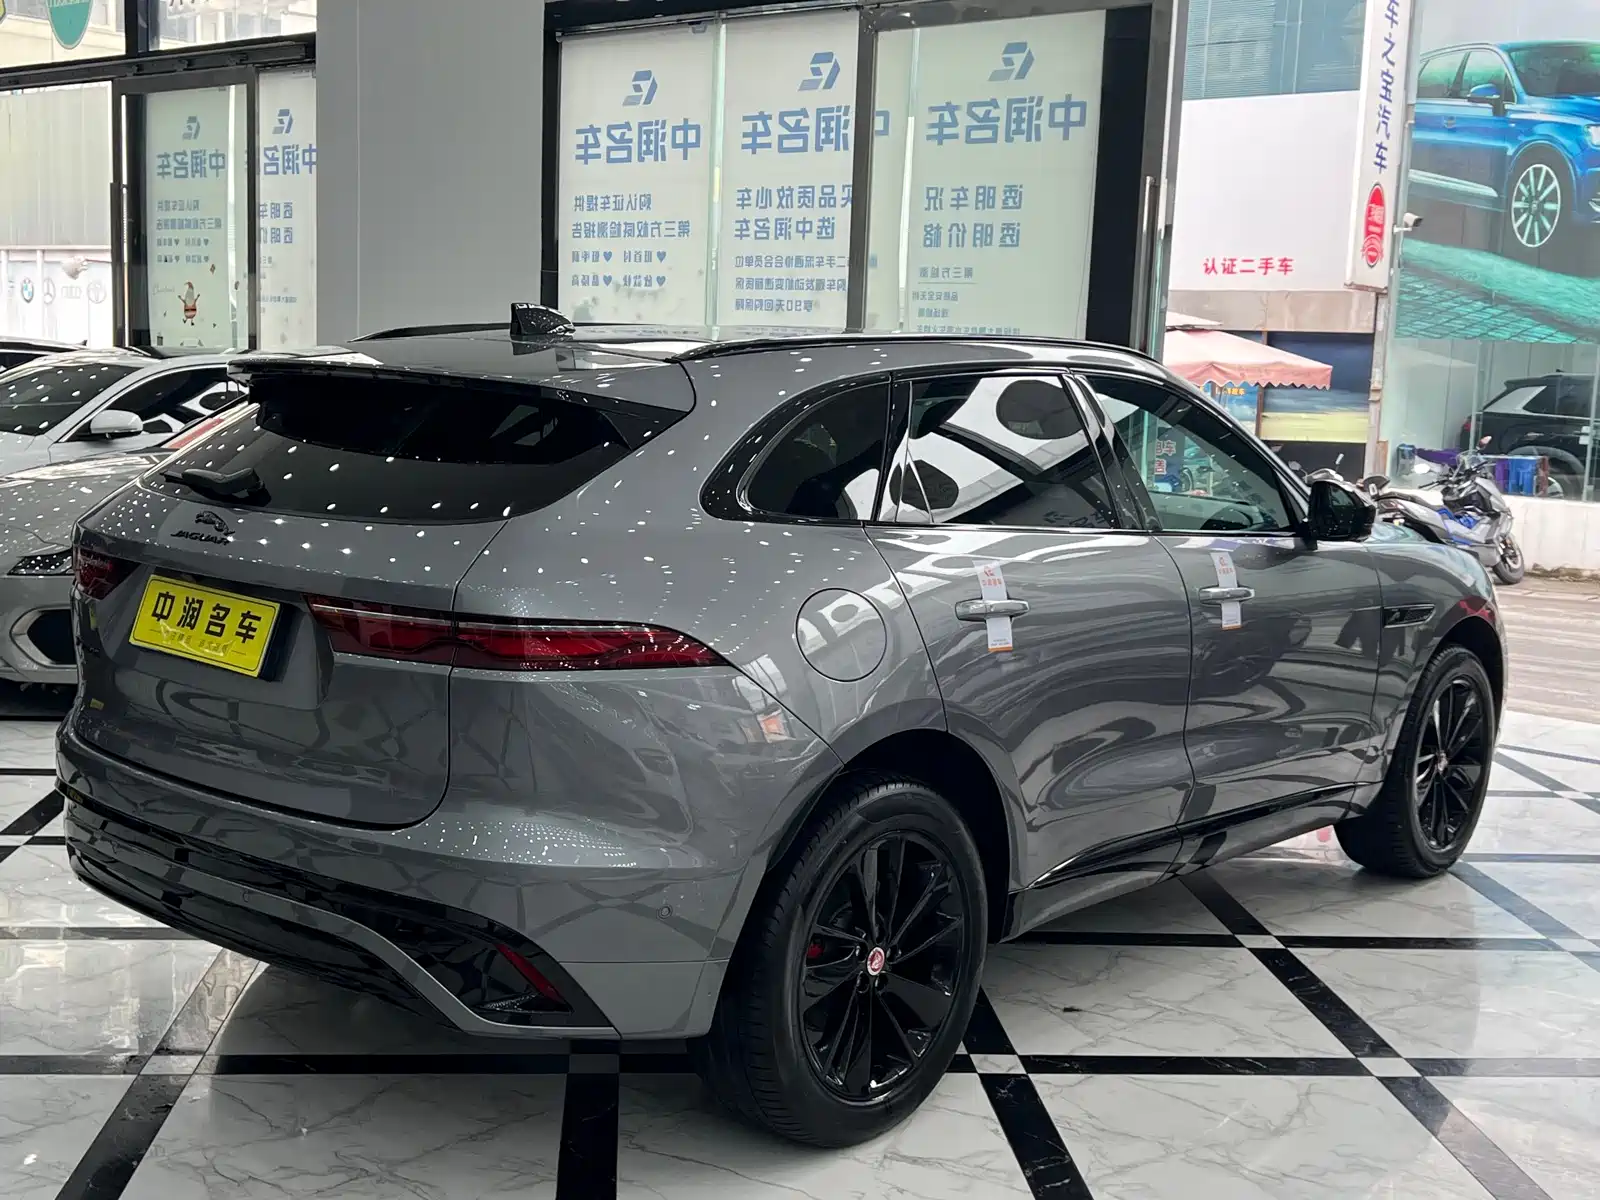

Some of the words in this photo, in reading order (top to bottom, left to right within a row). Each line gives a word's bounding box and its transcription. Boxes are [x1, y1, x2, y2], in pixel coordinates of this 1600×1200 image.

[1203, 257, 1294, 275] 认证二手车
[170, 530, 231, 546] JAGUAR
[151, 591, 262, 643] 中润名车
